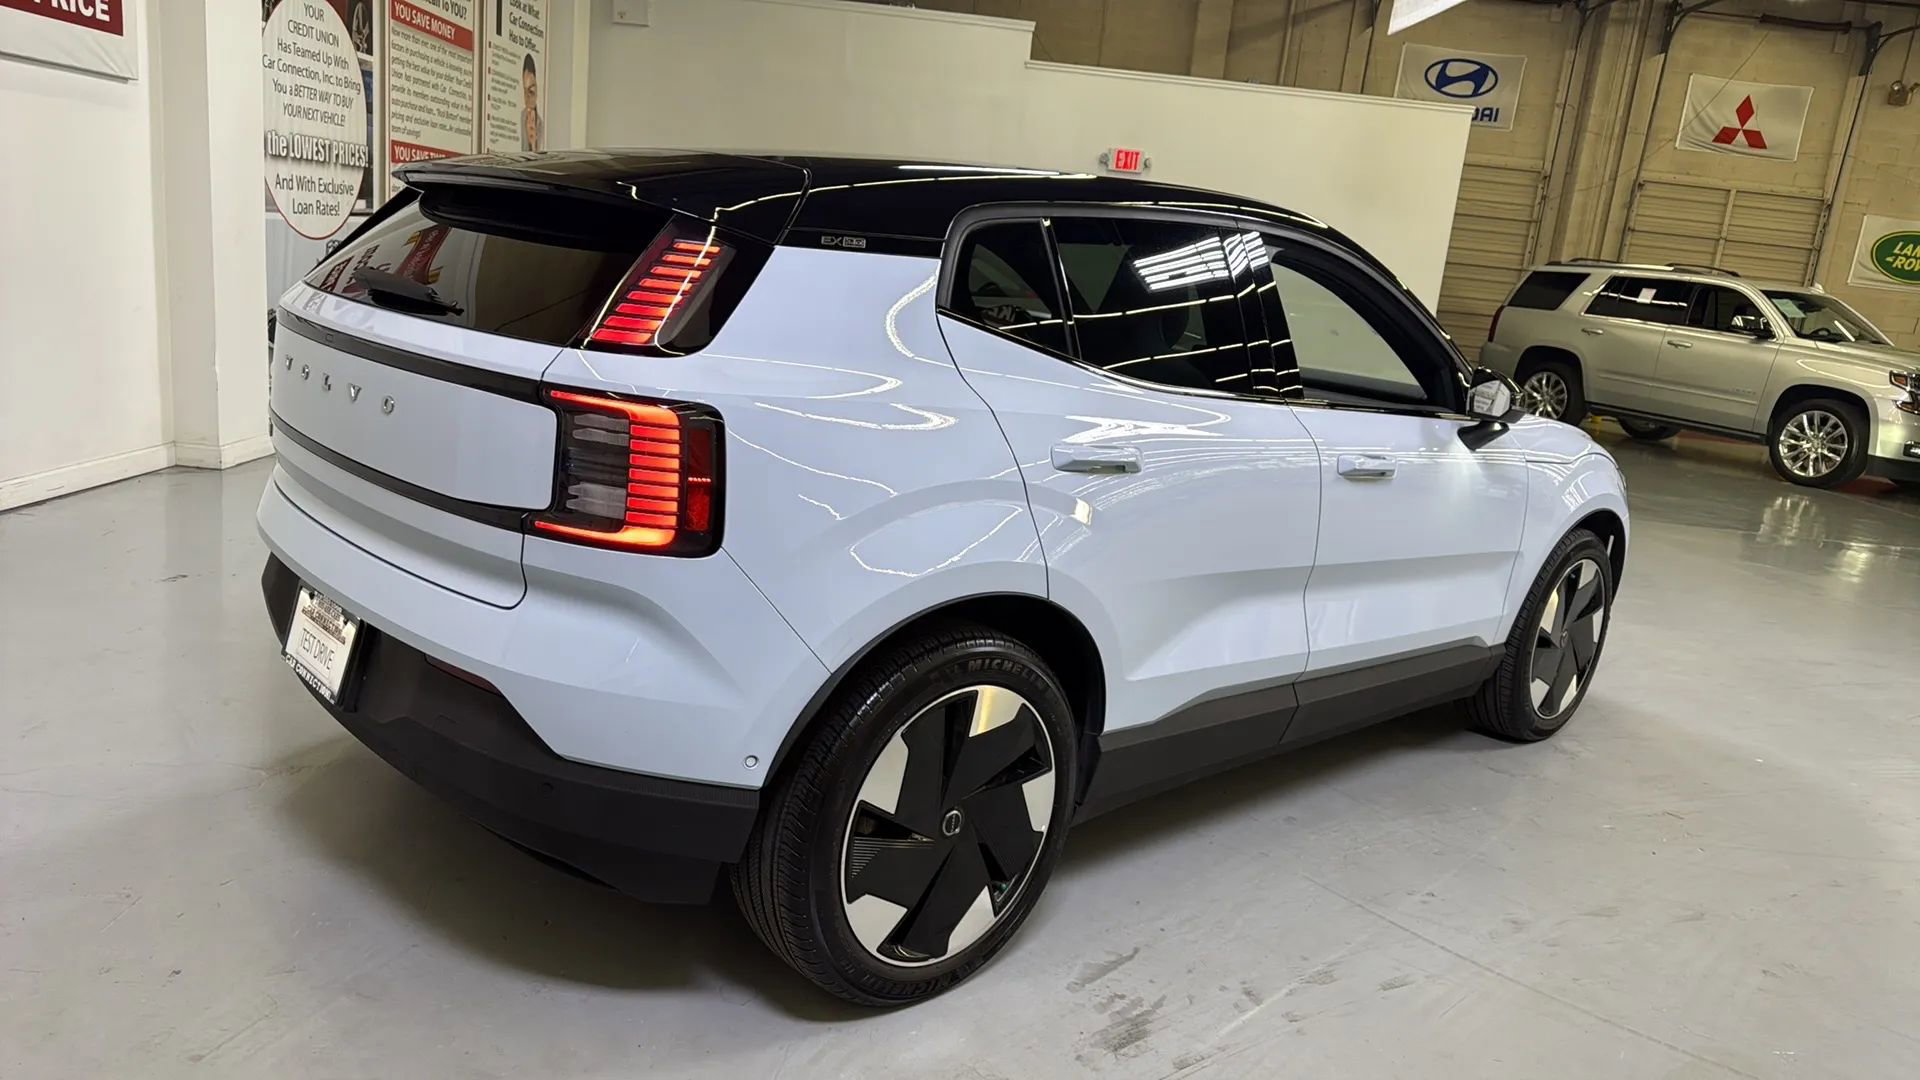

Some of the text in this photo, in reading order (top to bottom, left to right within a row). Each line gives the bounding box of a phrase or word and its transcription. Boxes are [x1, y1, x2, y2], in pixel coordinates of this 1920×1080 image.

[303, 3, 324, 21] YOUR
[395, 2, 456, 40] YOU SAVE MONEY
[288, 19, 339, 47] CREDIT UNION
[277, 37, 349, 70] Has Teamed Up With
[262, 54, 275, 70] Car
[277, 59, 321, 83] Connection,
[335, 75, 343, 88] to
[344, 76, 360, 95] Bring
[272, 78, 354, 109] You a BETTER WAY TO BUY
[283, 102, 302, 119] YOUR
[302, 107, 320, 121] NEXT
[267, 130, 369, 168] the LOWEST PRICES!
[394, 145, 410, 161] YOU
[411, 148, 429, 161] SAVE
[1115, 150, 1140, 170] EXIT
[275, 173, 354, 196] And With Exclusive
[292, 198, 340, 217] Loan Rates!
[285, 354, 396, 415] VOLVO
